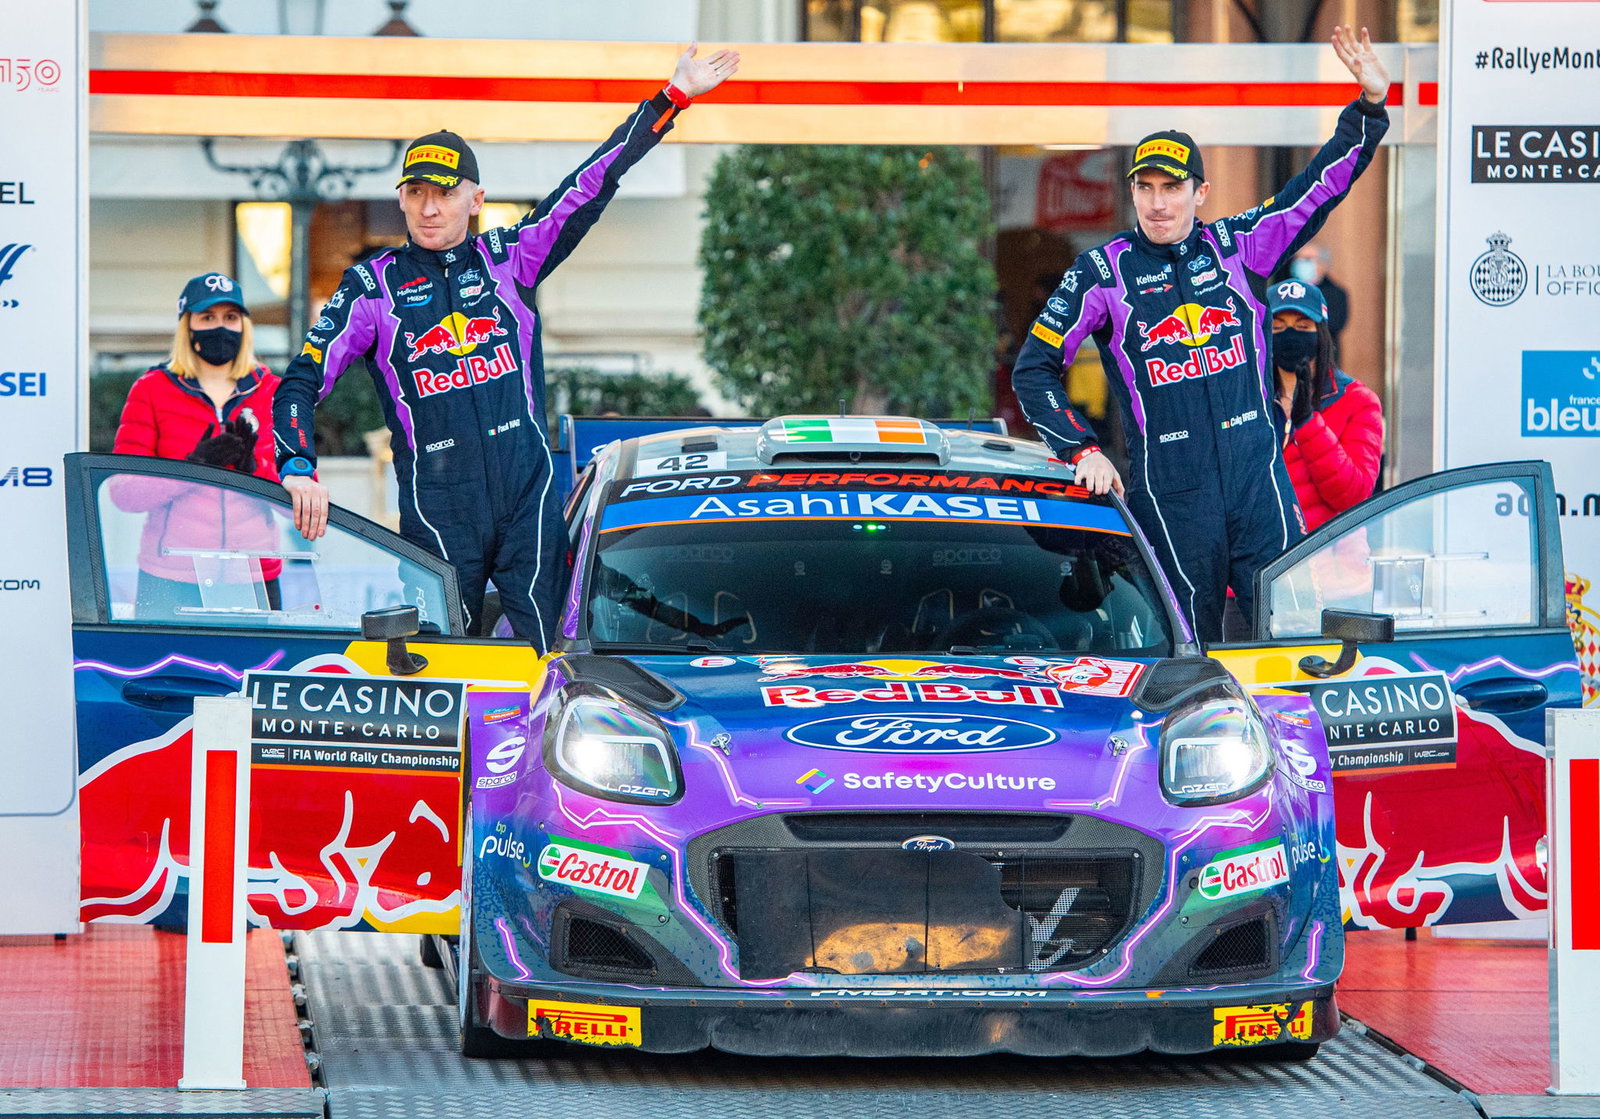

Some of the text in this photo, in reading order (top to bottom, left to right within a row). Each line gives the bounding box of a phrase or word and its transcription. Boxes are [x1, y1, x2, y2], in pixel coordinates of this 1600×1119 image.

[408, 147, 454, 164] PIRELLI
[1138, 142, 1185, 158] PIRELLI
[1477, 131, 1511, 158] LE
[1487, 164, 1563, 178] MONTE
[1089, 249, 1111, 280] sparco
[1136, 271, 1168, 286] Keltech
[412, 342, 518, 398] Red Bull
[1145, 333, 1248, 388] Red Bull
[1527, 398, 1600, 431] bleu
[657, 454, 709, 472] 42
[620, 472, 1091, 499] FORD PERFORMANCE
[252, 681, 291, 710] LE
[299, 683, 454, 717] CASINO
[760, 682, 1064, 708] Red Bull
[1321, 682, 1444, 718] CASINO
[261, 718, 441, 740] MONTE CARLO
[835, 716, 1008, 746] Ford
[1378, 718, 1440, 736] CARLO
[292, 749, 312, 760] FIA
[314, 750, 347, 762] World
[350, 752, 378, 765] Rally
[381, 753, 460, 768] Championship
[1338, 752, 1404, 767] Championship
[478, 772, 517, 788] sparco
[843, 772, 1057, 793] SafetyCulture
[479, 832, 526, 860] pulse
[557, 852, 639, 894] Castrol
[1223, 850, 1287, 892] Castrol
[535, 1007, 629, 1038] PRELLI
[1225, 1009, 1306, 1039] PIRELI
